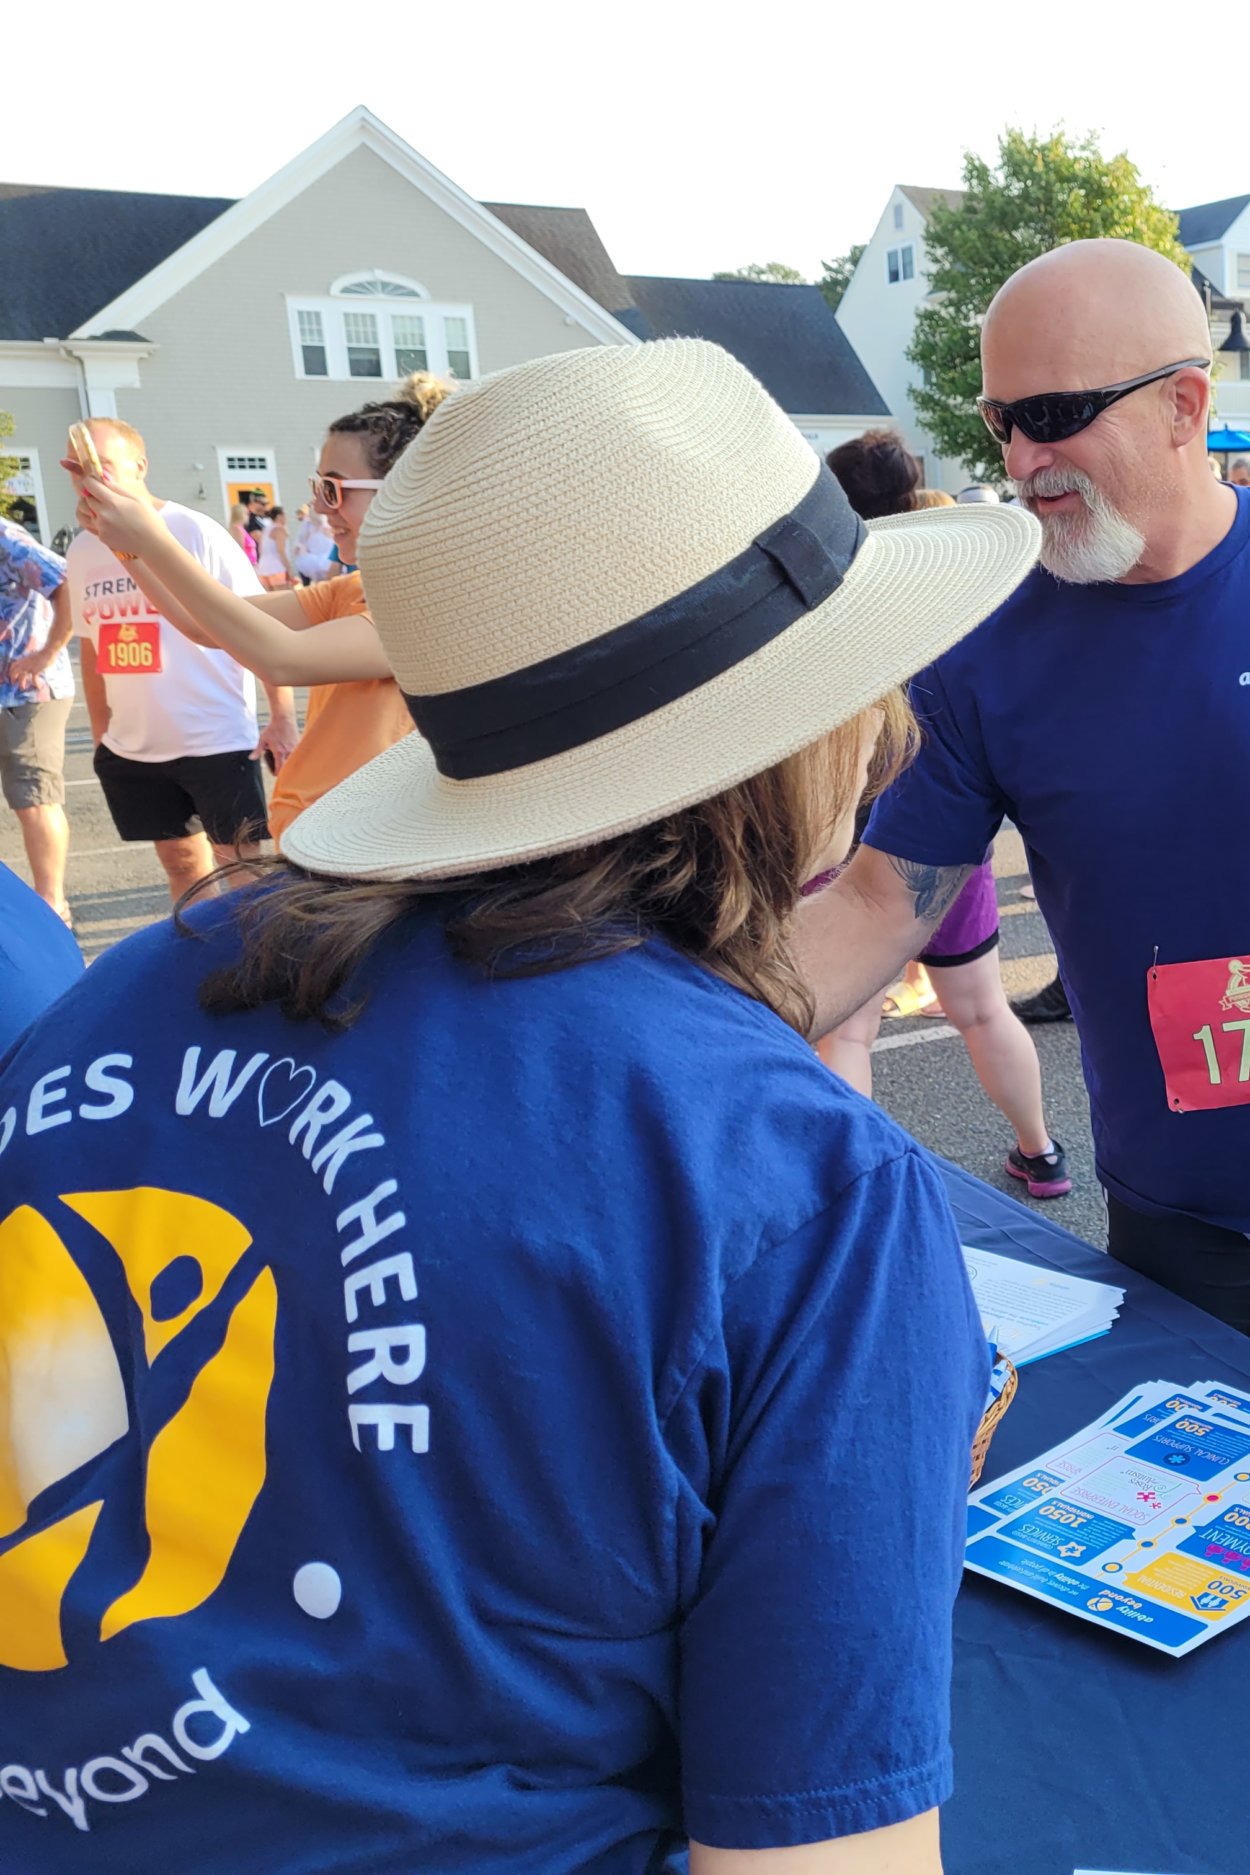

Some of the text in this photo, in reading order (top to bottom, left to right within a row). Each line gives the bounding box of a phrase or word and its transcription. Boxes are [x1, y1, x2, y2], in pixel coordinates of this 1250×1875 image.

[108, 642, 153, 667] 1906
[336, 1178, 430, 1454] HERE
[1174, 1420, 1210, 1436] 500
[1152, 1434, 1194, 1453] SUPPORTS
[1192, 1448, 1230, 1466] CLINICAL
[1037, 1504, 1087, 1528] 1050
[1051, 1500, 1095, 1519] INDIVIDUALS
[1018, 1522, 1065, 1545] SERVICES
[1137, 1574, 1186, 1599] RESIDENTIAL
[1206, 1578, 1248, 1601] 500
[1097, 1590, 1143, 1611] beyond
[1115, 1606, 1154, 1624] ability
[0, 1667, 251, 1831] eyond
